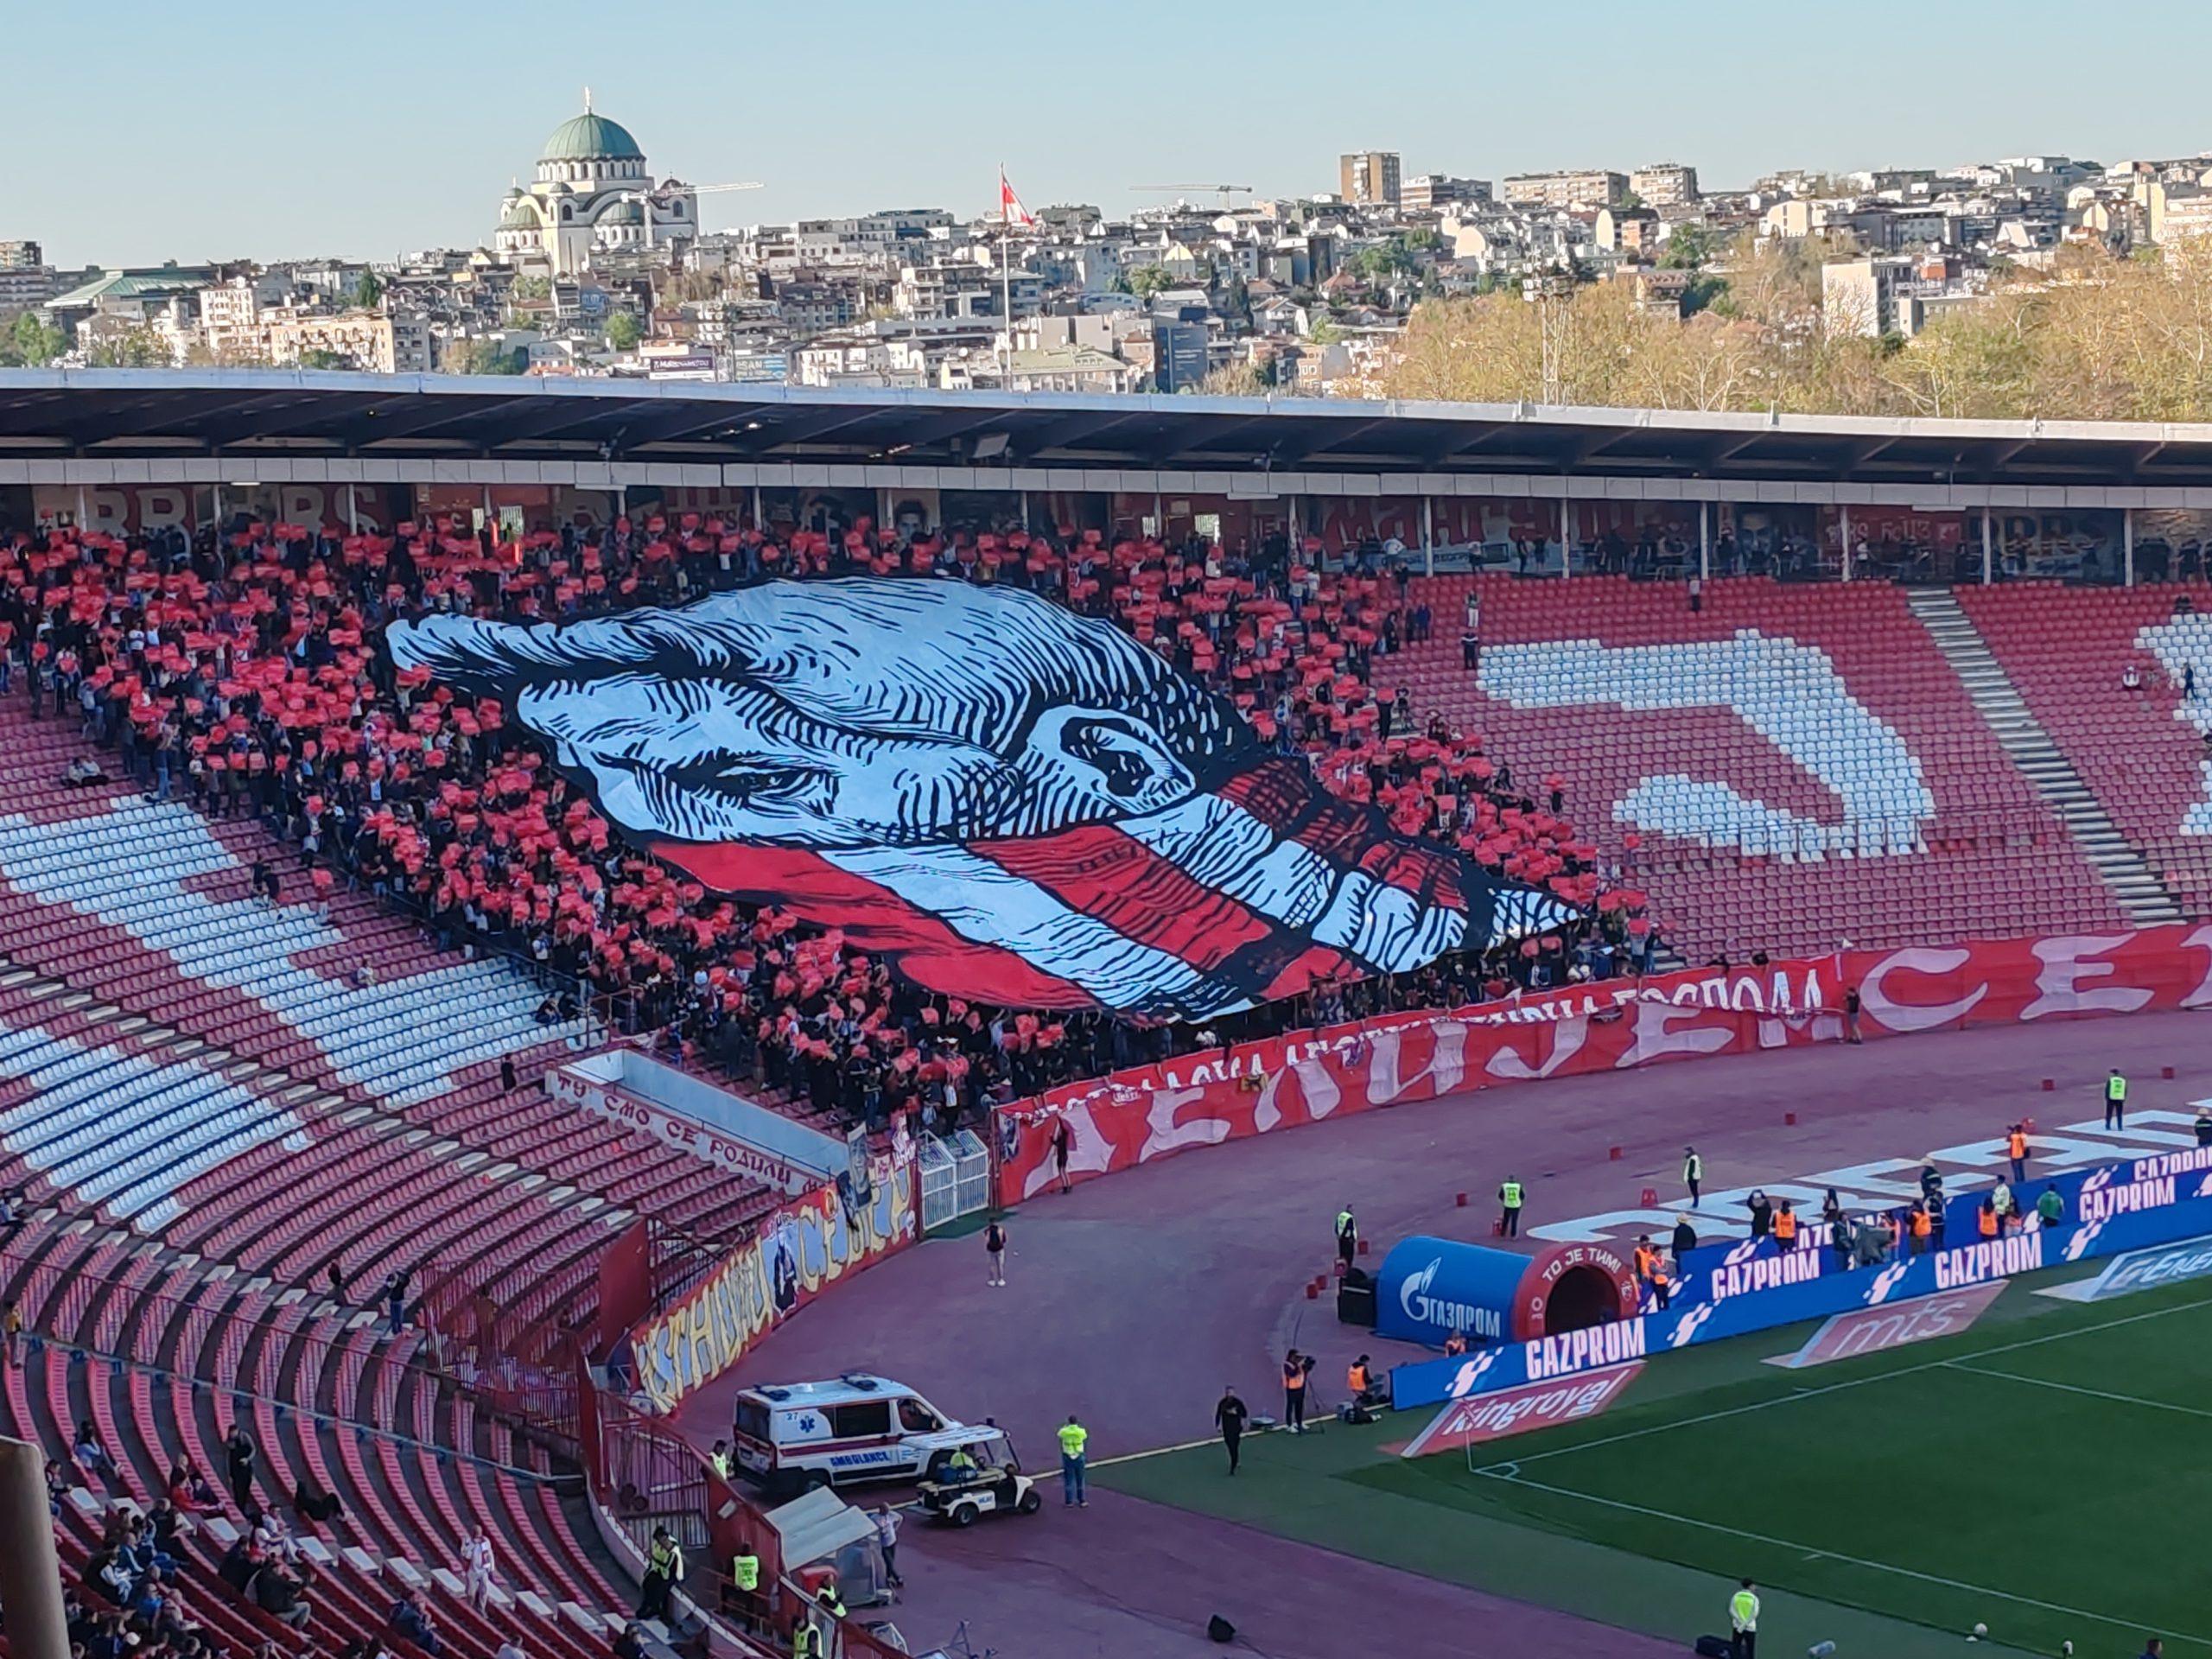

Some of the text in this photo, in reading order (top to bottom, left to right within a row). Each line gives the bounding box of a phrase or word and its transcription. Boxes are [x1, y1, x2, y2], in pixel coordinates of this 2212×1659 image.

[604, 1095, 650, 1125] СМО
[666, 1121, 697, 1146] СЕ
[710, 1140, 791, 1185] РОДИЛИ
[2079, 1176, 2176, 1223] GAZPROM
[1711, 1249, 1820, 1300] GAZPROM
[1935, 1231, 2042, 1288] GAZPROM
[1430, 1298, 1501, 1338] ГАЗПРОМ
[1830, 1300, 1967, 1358] mts
[1525, 1317, 1646, 1380] GAZPROM
[830, 1450, 891, 1467] AMBULANCE
